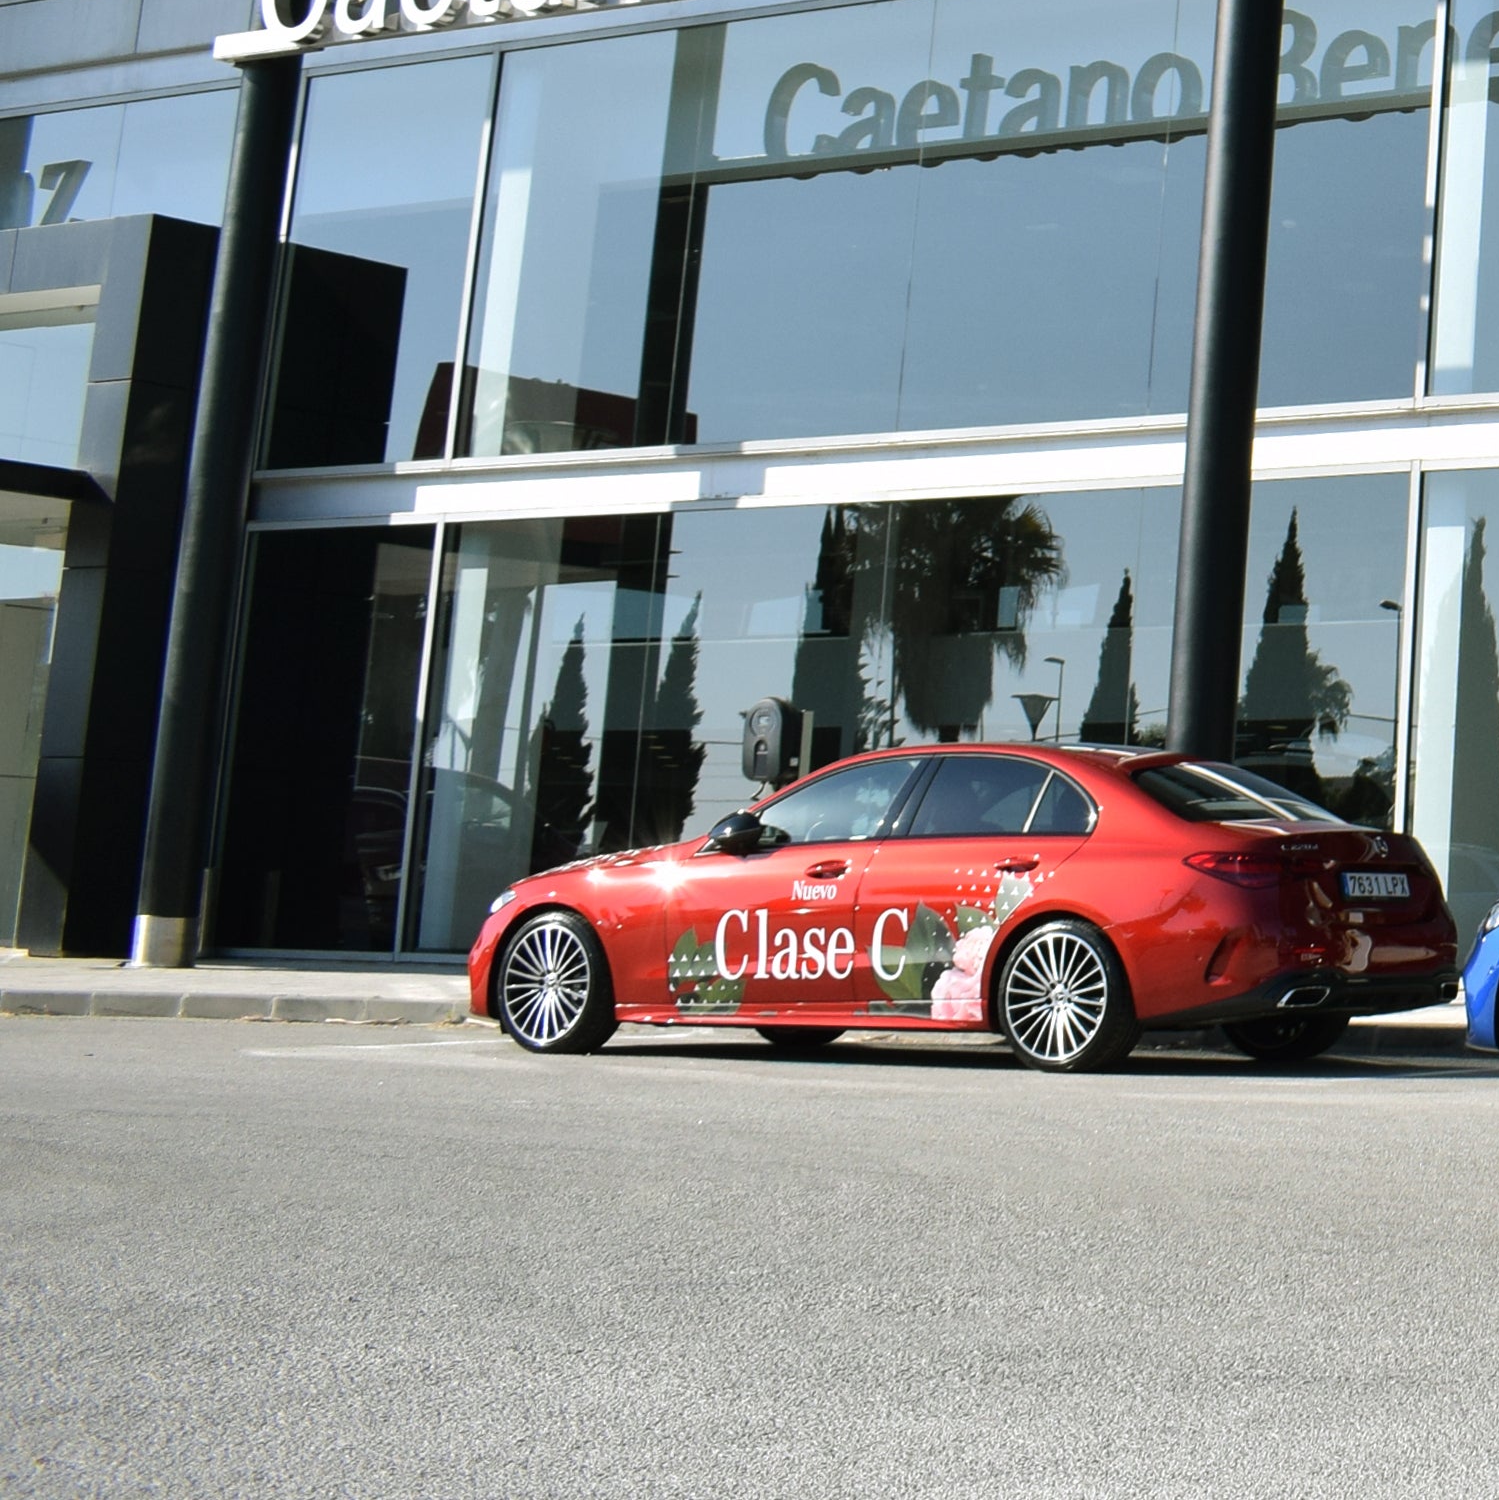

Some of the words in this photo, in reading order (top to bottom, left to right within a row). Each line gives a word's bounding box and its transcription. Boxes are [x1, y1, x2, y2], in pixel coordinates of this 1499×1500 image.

[791, 880, 837, 901] Nuevo
[1349, 876, 1382, 894] 7631
[1384, 875, 1408, 895] LPX
[714, 908, 855, 980] Clase
[871, 908, 908, 981] C
